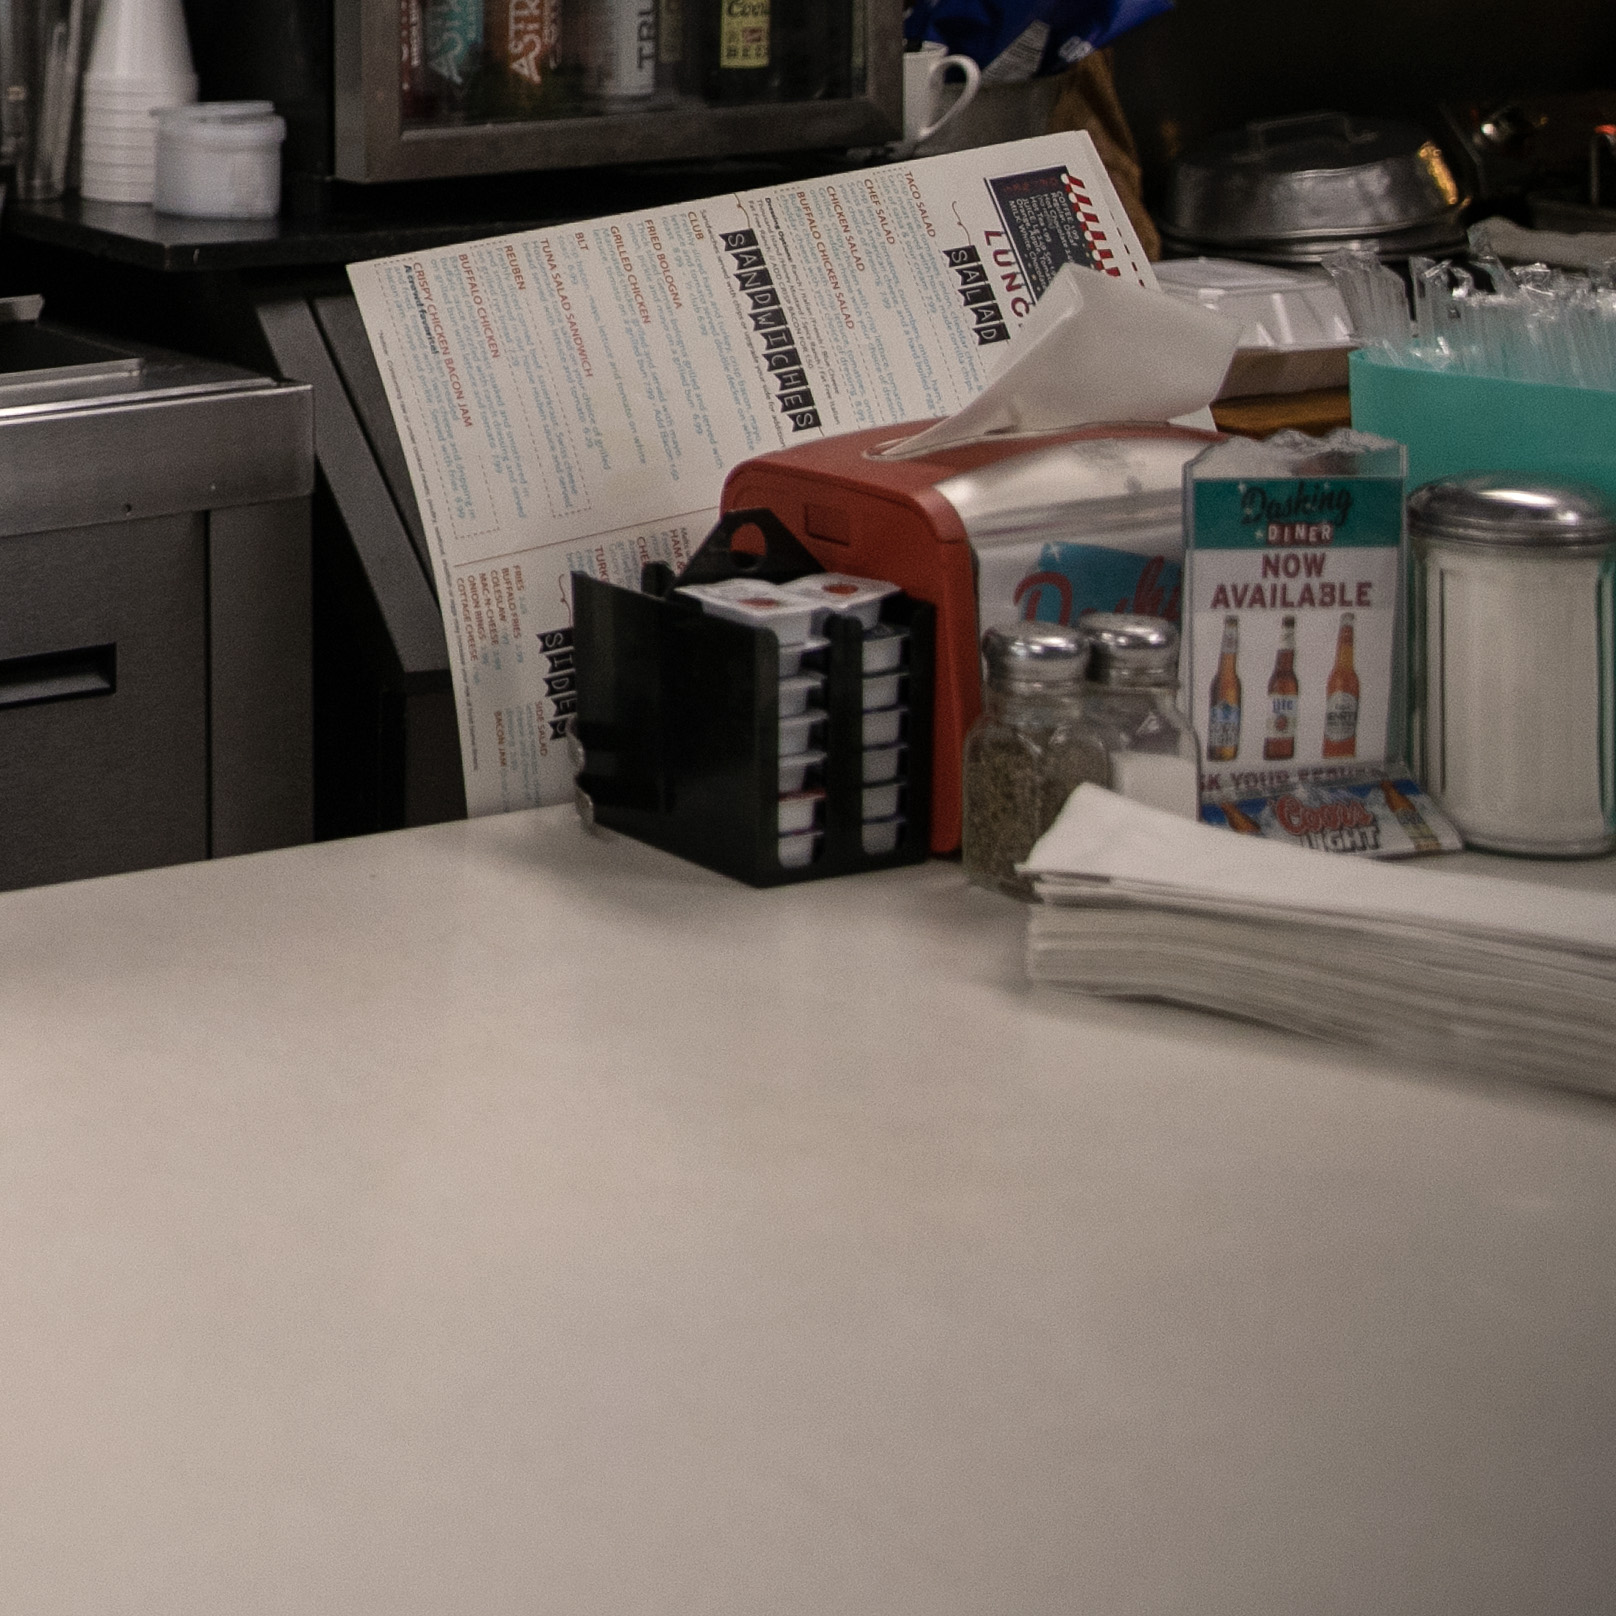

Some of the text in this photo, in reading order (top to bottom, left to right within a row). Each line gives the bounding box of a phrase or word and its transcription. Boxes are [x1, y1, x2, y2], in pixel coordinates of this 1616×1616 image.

[574, 231, 589, 251] BLT
[686, 211, 704, 240] CLUB
[825, 185, 866, 271] CHICKEN SALAD
[862, 178, 896, 244] CHEF SALAD
[903, 171, 937, 237] TACO SALAD
[503, 244, 527, 290] REUBEN
[609, 225, 651, 323] GRILLED CHICKEN
[643, 218, 683, 309] FRIED BOLOGNA
[795, 190, 855, 329] BUFFALO CHICKEN SALAD
[949, 249, 1000, 340] SALAD
[982, 227, 1035, 325] LUNC
[411, 261, 473, 427] CRISPY CHICKEN BACON JAM
[457, 253, 501, 358] BUFFALO CHICKEN
[539, 238, 594, 377] TUNA SALAD SANDWICH
[726, 232, 815, 425] SANDWICHES
[1240, 480, 1354, 526] Dashing
[1267, 522, 1334, 545] DINER
[1210, 582, 1374, 610] AVAILABLE
[1261, 553, 1327, 579] NOW
